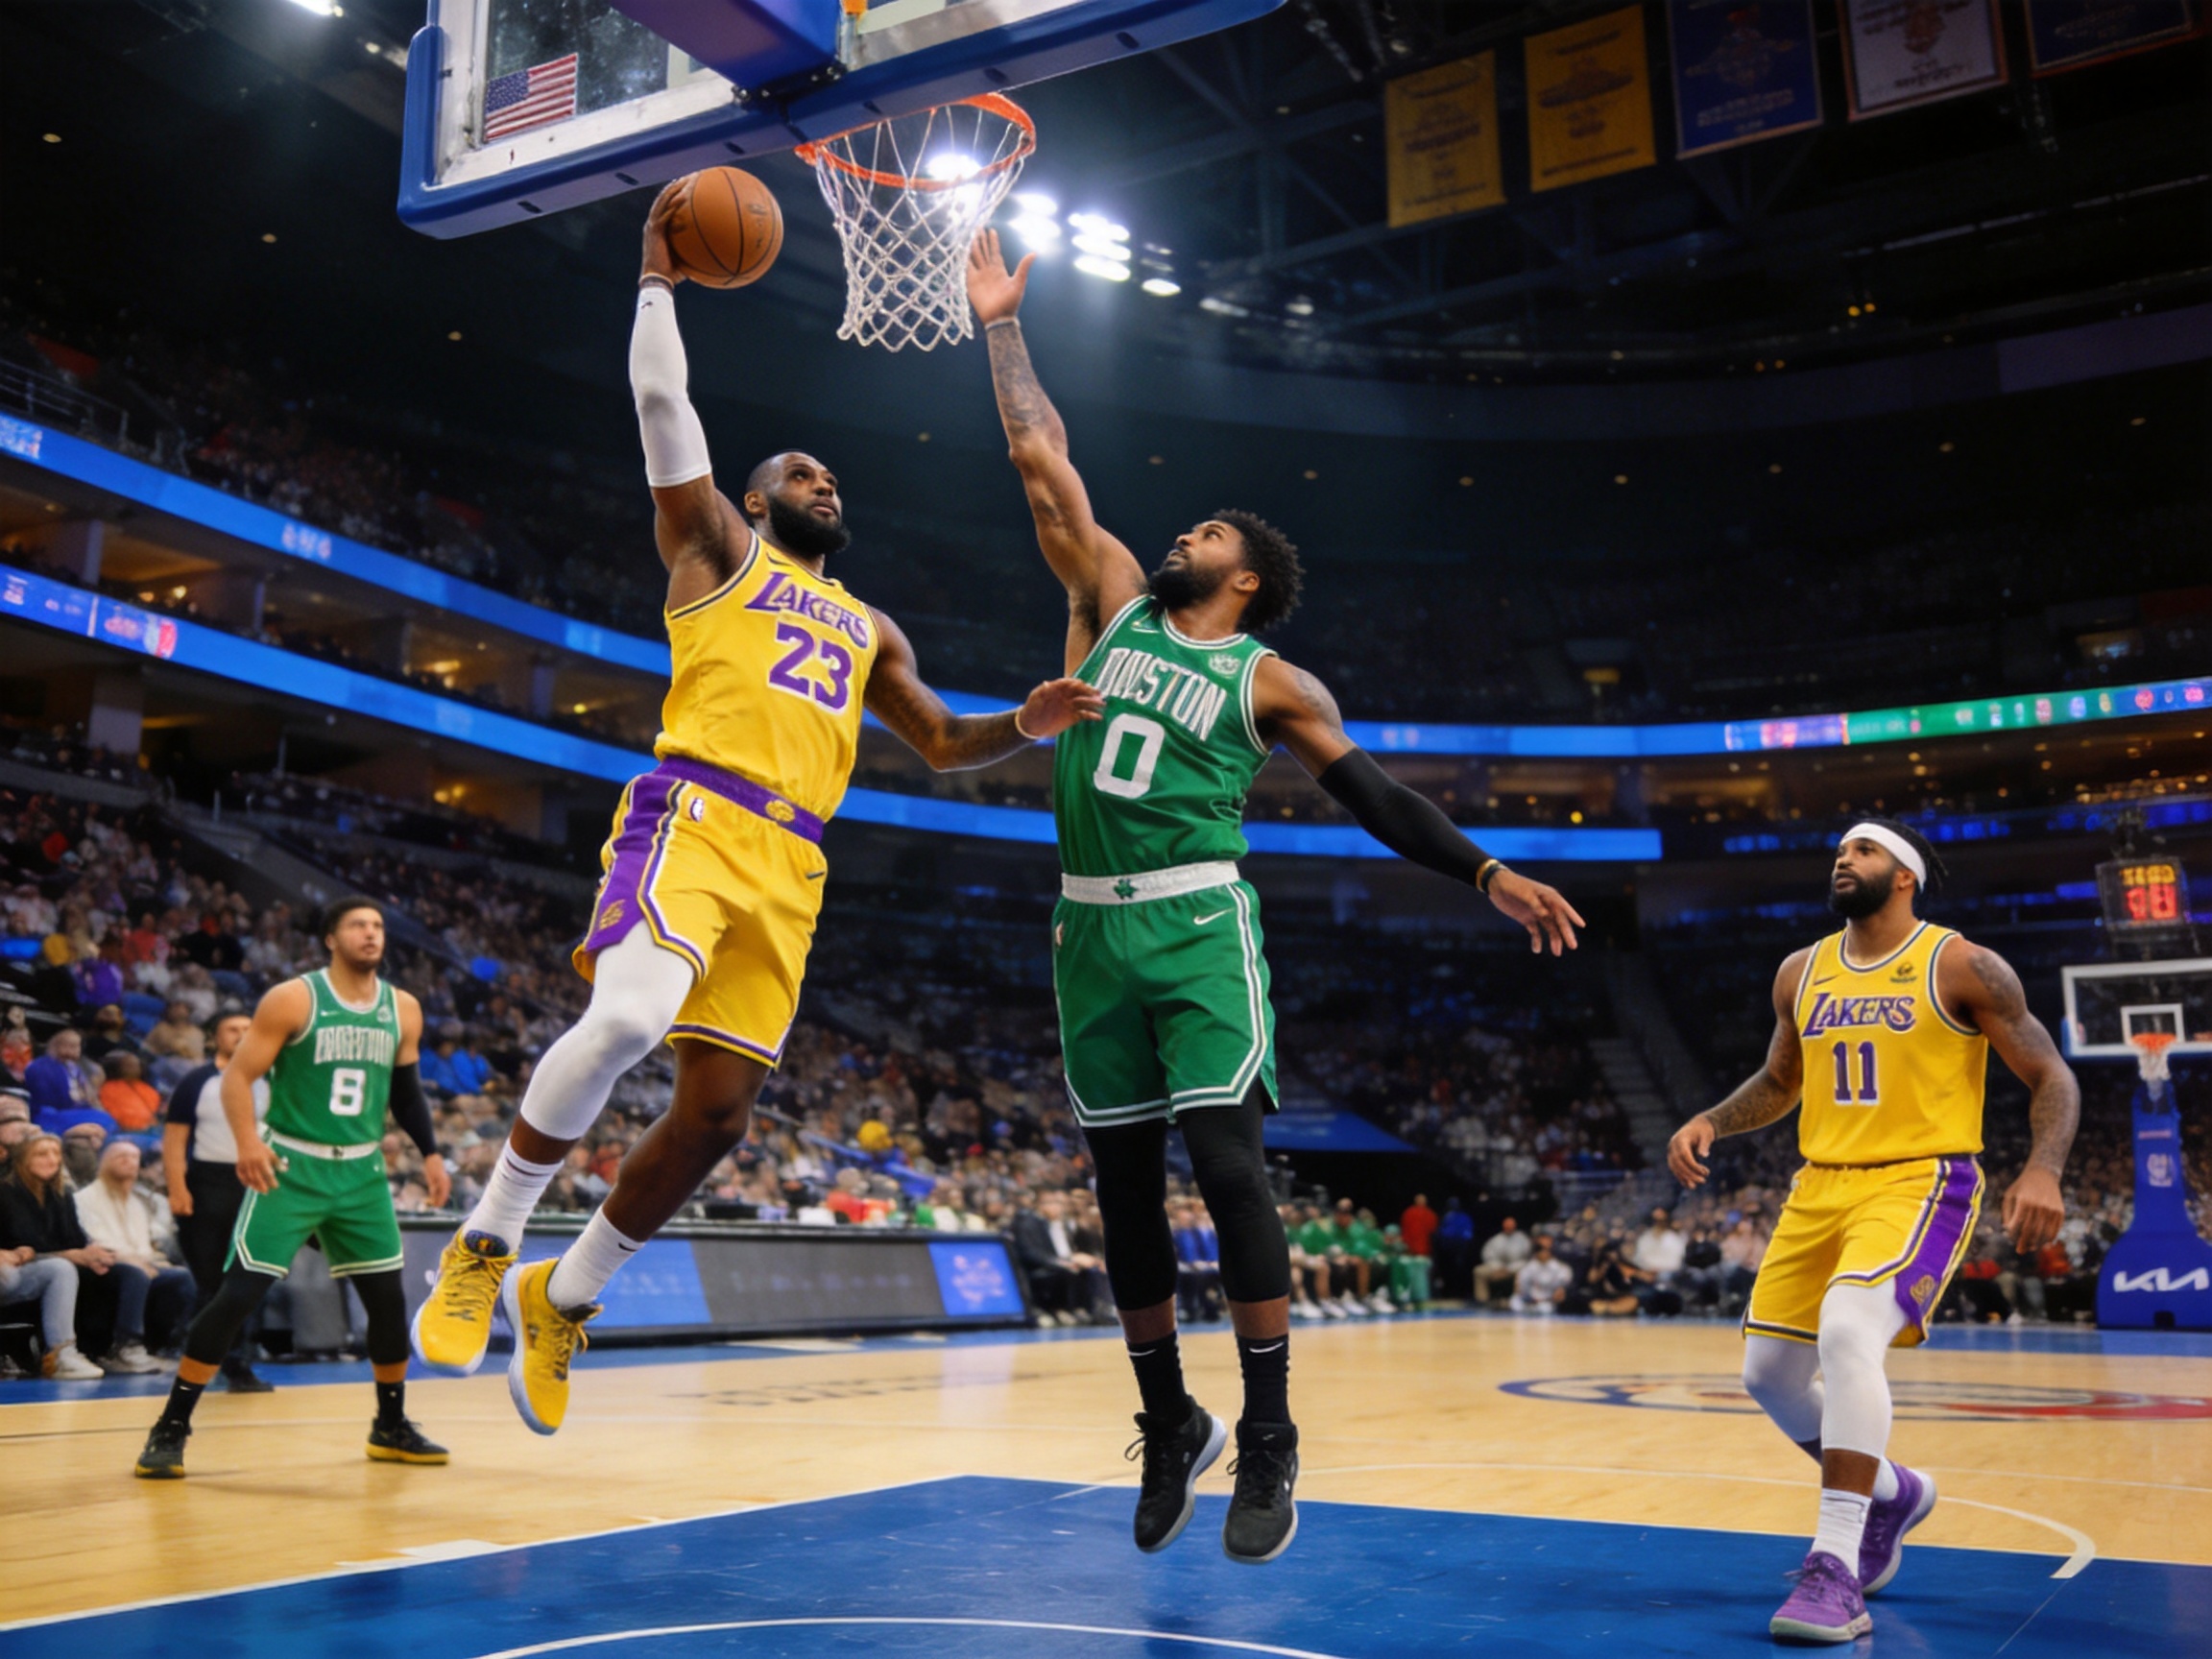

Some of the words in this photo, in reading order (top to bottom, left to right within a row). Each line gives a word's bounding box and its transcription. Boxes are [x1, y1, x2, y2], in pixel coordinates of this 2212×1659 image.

[744, 571, 869, 649] LAKERS
[768, 622, 854, 714] 23
[1093, 713, 1165, 799] 0
[1802, 992, 1916, 1038] LAKERS
[329, 1067, 367, 1116] 8
[1832, 1041, 1880, 1105] 11
